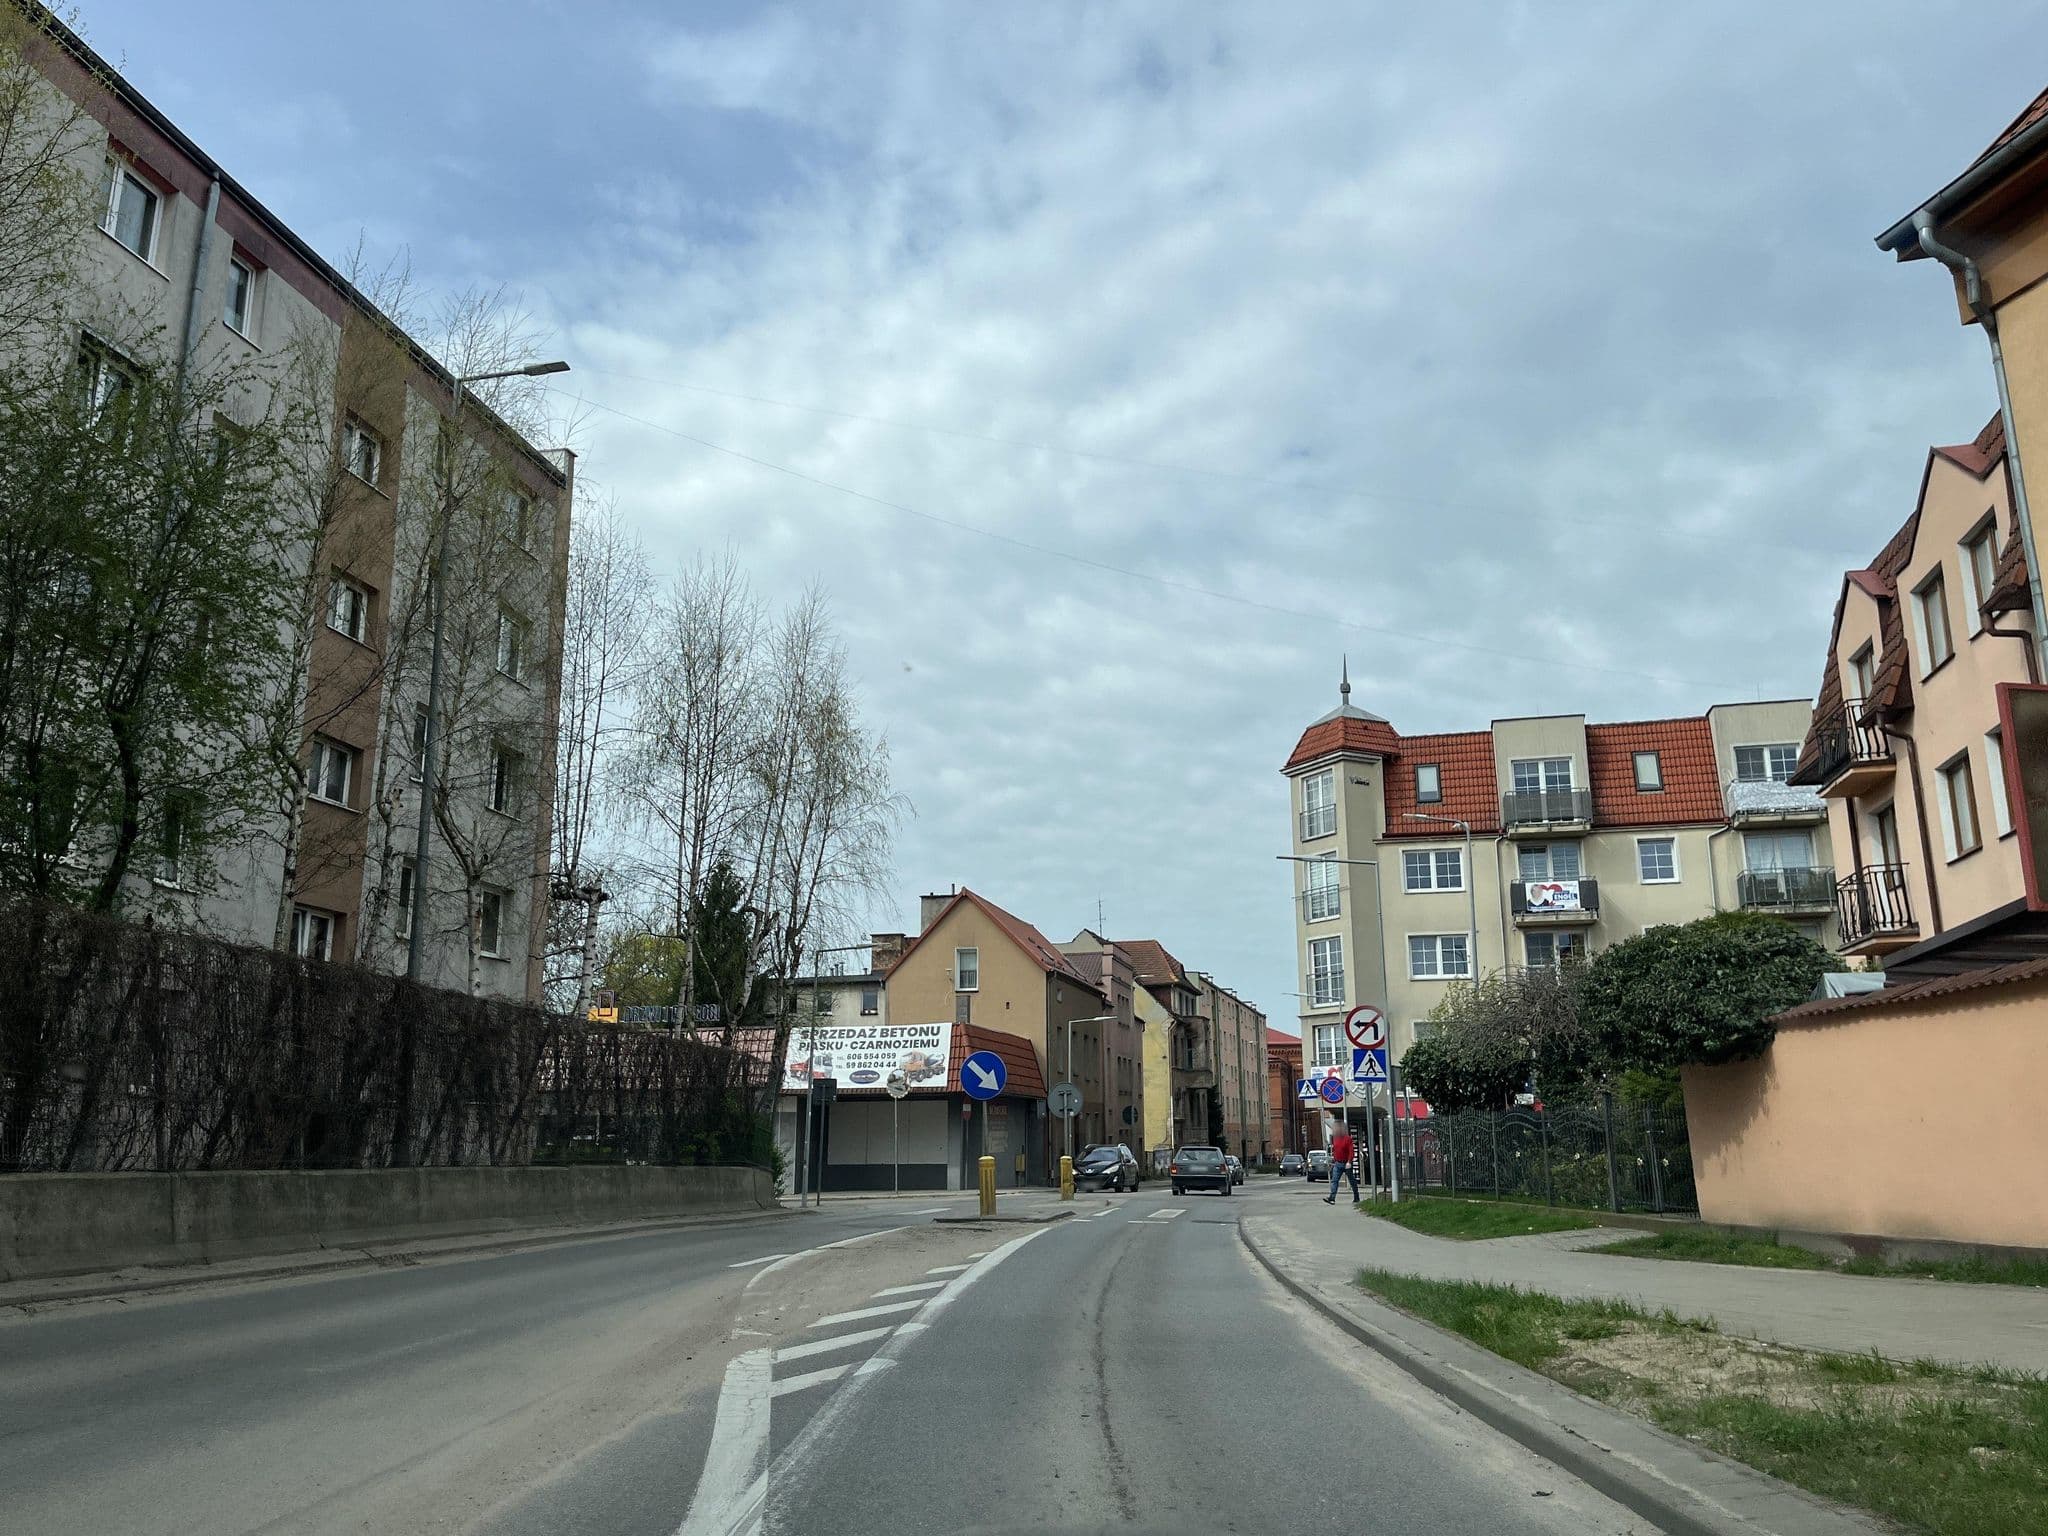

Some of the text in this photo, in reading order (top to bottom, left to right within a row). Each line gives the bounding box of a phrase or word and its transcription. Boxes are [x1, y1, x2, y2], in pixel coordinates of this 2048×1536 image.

[801, 1025, 941, 1040] SPRZEDAŻ BETONU
[798, 1039, 940, 1051] PIASKU CZARNOZIEMU
